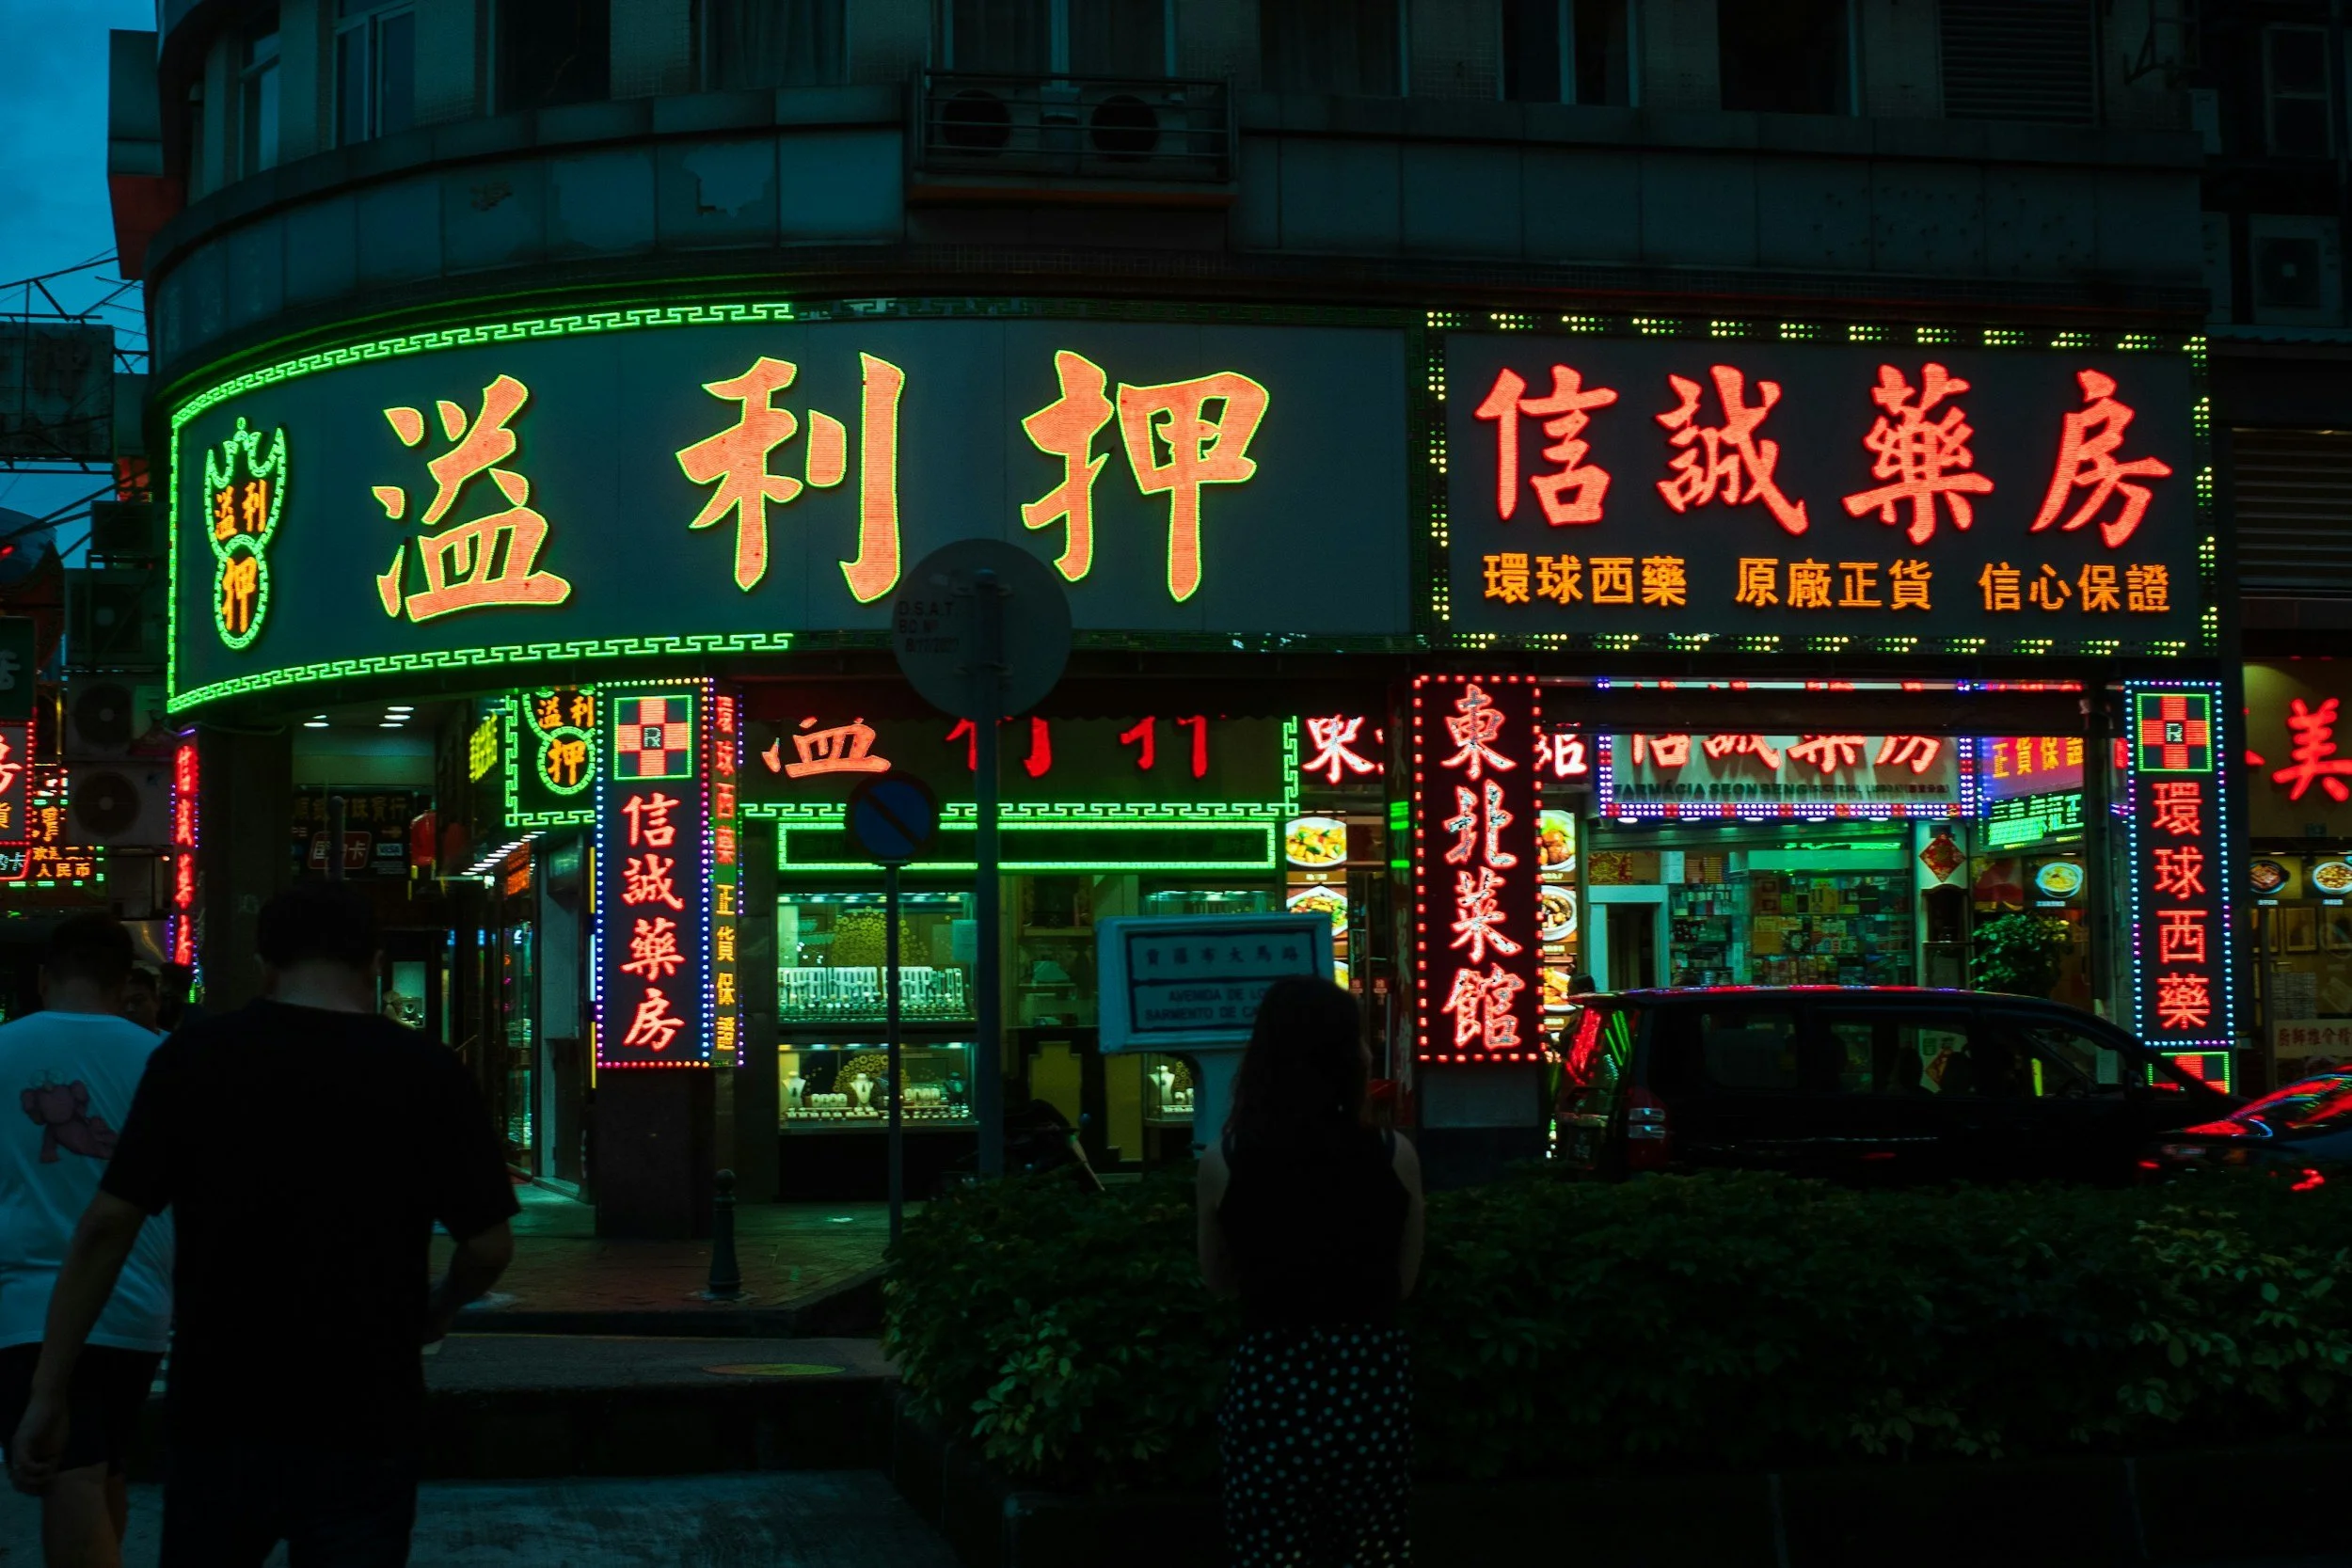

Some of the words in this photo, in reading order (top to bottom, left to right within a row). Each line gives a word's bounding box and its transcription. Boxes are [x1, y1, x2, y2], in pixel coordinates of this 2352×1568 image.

[372, 352, 1269, 623] 溢利押
[1474, 363, 2172, 547] 信誠藥房
[213, 478, 268, 541] 溢利
[222, 556, 257, 633] 押
[1484, 552, 1687, 607] 環球西藥
[1735, 557, 1933, 610] 原廠正貨
[1978, 562, 2170, 612] 信心保證
[537, 694, 595, 730] 溢利
[2245, 697, 2352, 802] 美
[547, 737, 586, 786] 押
[714, 695, 737, 864] 環球西藥
[1613, 780, 1706, 796] FARMÁCIA
[1439, 684, 1526, 1050] 東北菜館
[621, 793, 685, 1052] 信誠藥房
[2153, 782, 2211, 1030] 環球西藥
[1144, 1006, 1214, 1022] SARMENTO
[1219, 1006, 1236, 1019] DE
[1168, 988, 1222, 1003] AVENIDA
[1227, 988, 1245, 1001] DE
